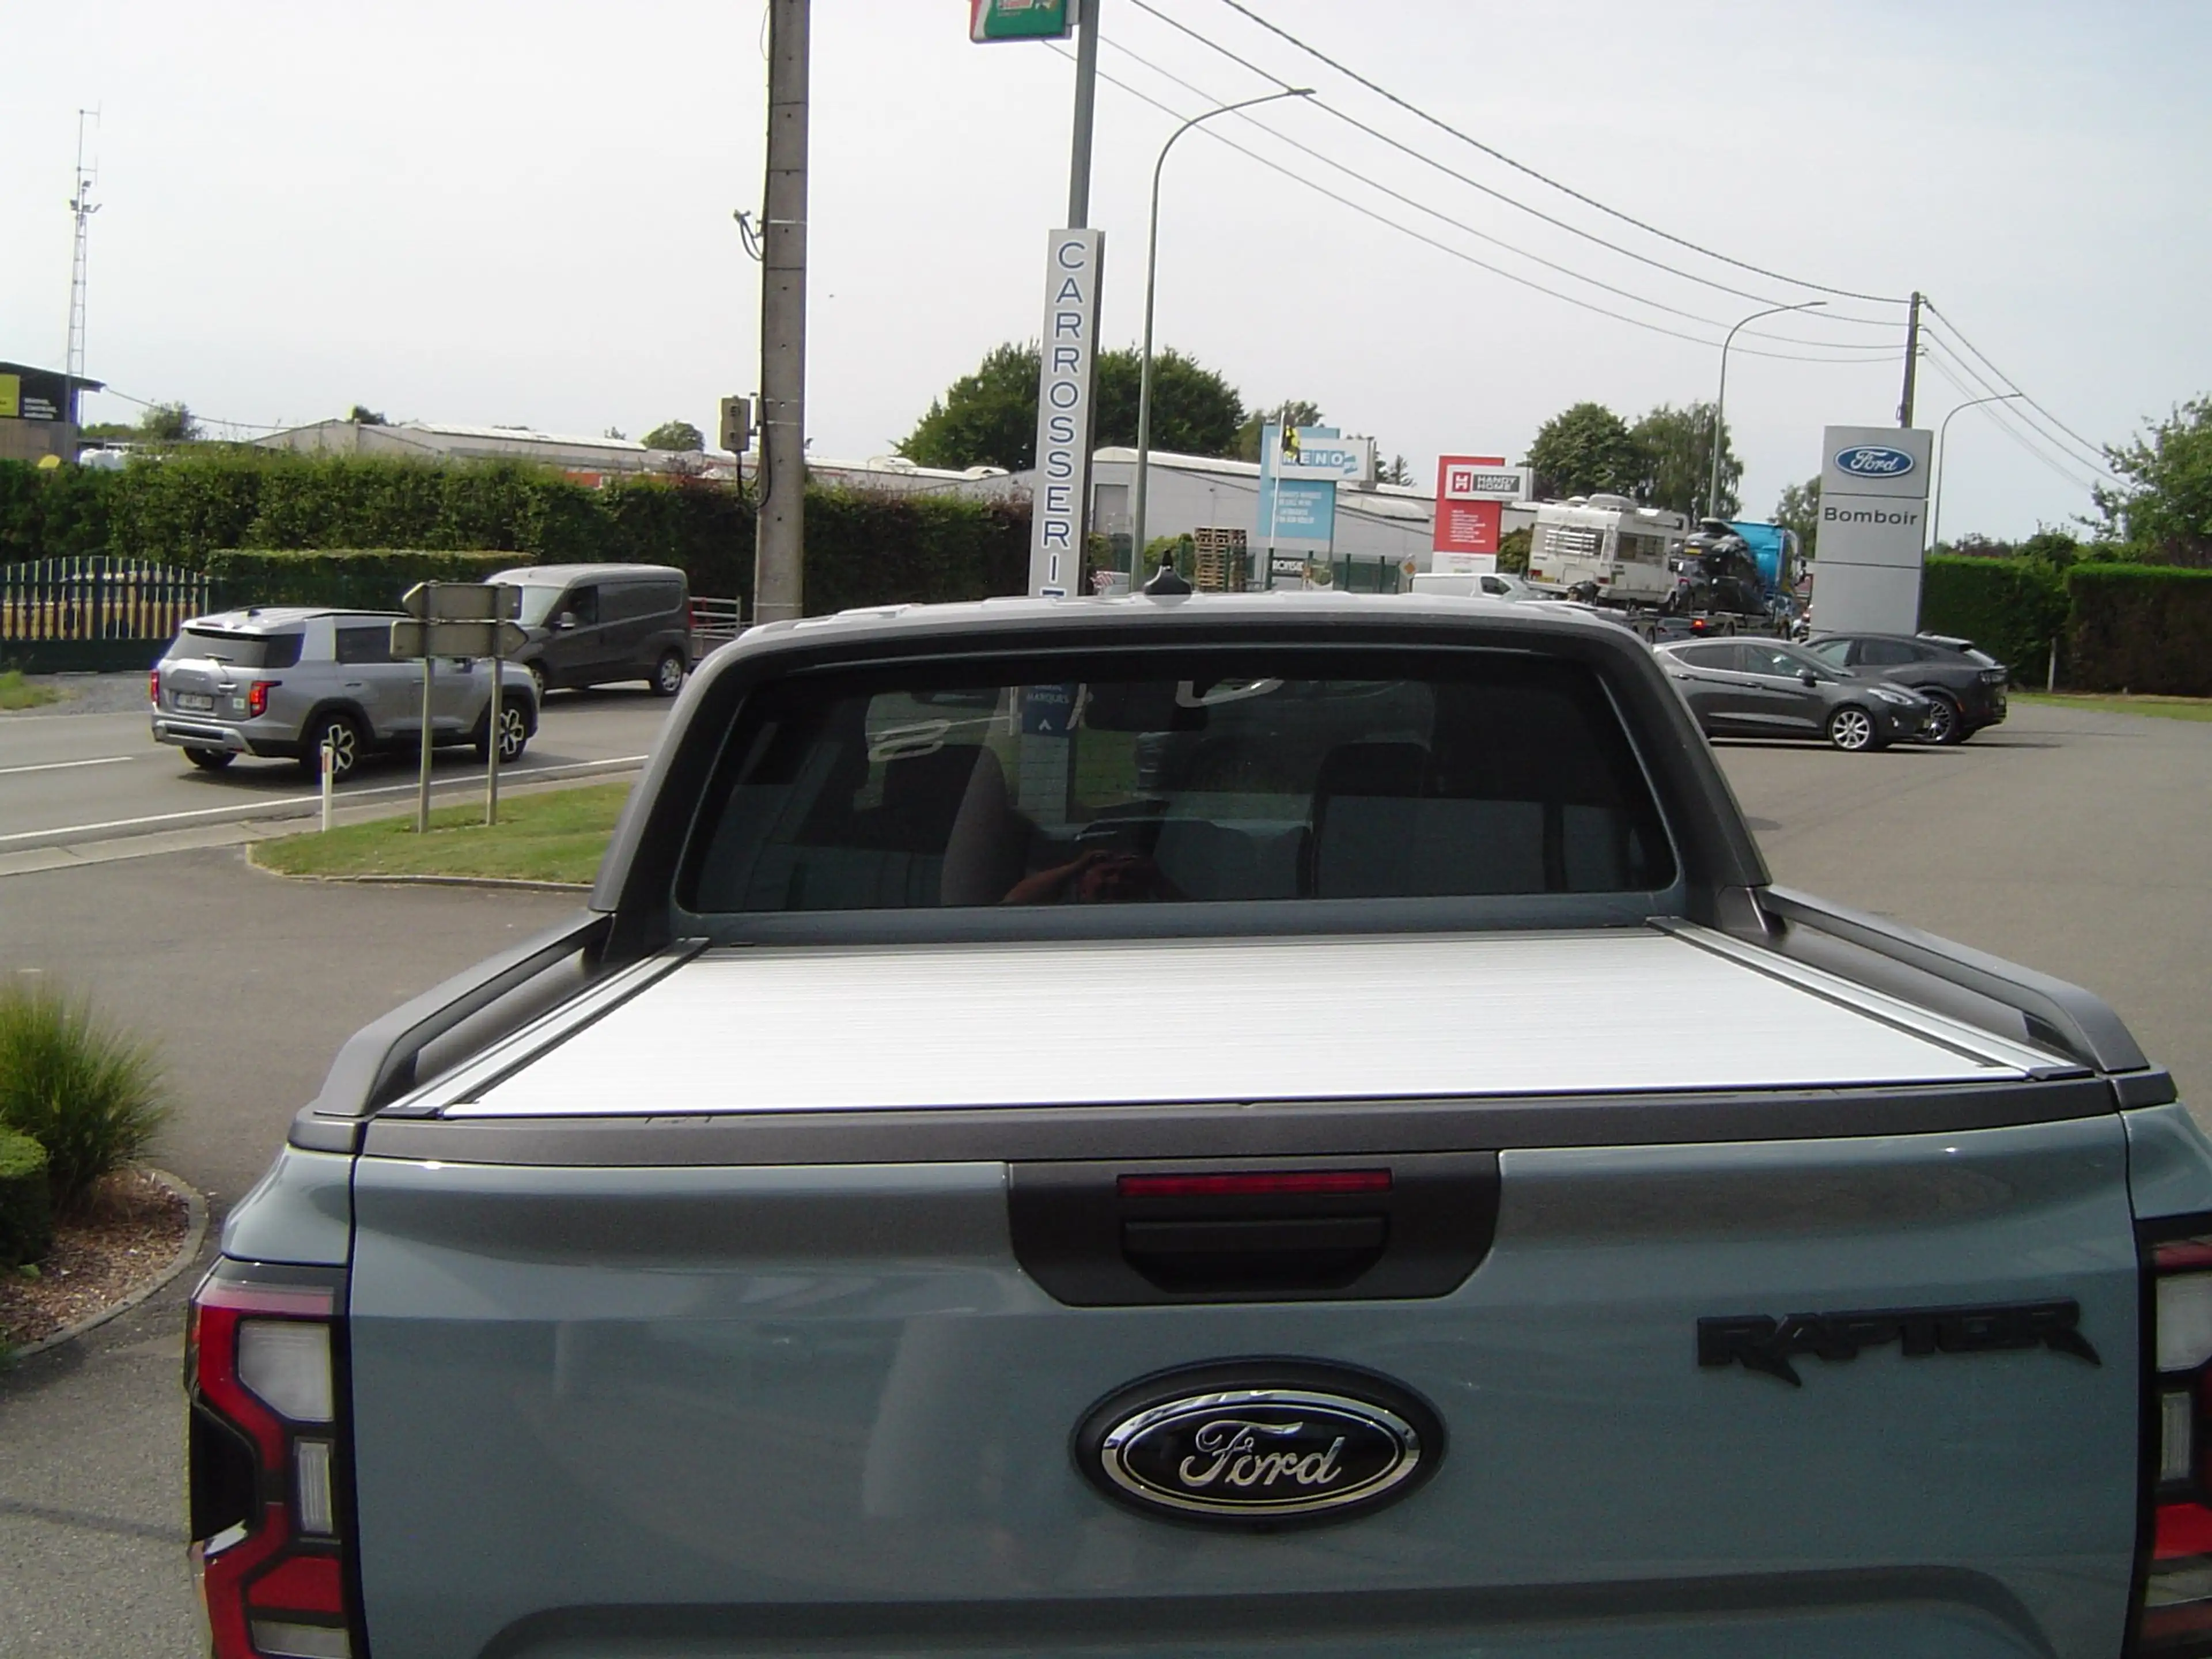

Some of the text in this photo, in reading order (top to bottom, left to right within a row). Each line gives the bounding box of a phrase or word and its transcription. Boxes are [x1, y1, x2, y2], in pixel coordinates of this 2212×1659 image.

[1042, 241, 1086, 599] CARROSSERI
[1850, 450, 1898, 471] Ford
[1824, 507, 1918, 525] Bomboir
[1696, 1296, 2103, 1387] RAPTOR
[1179, 1419, 1347, 1487] Ford
